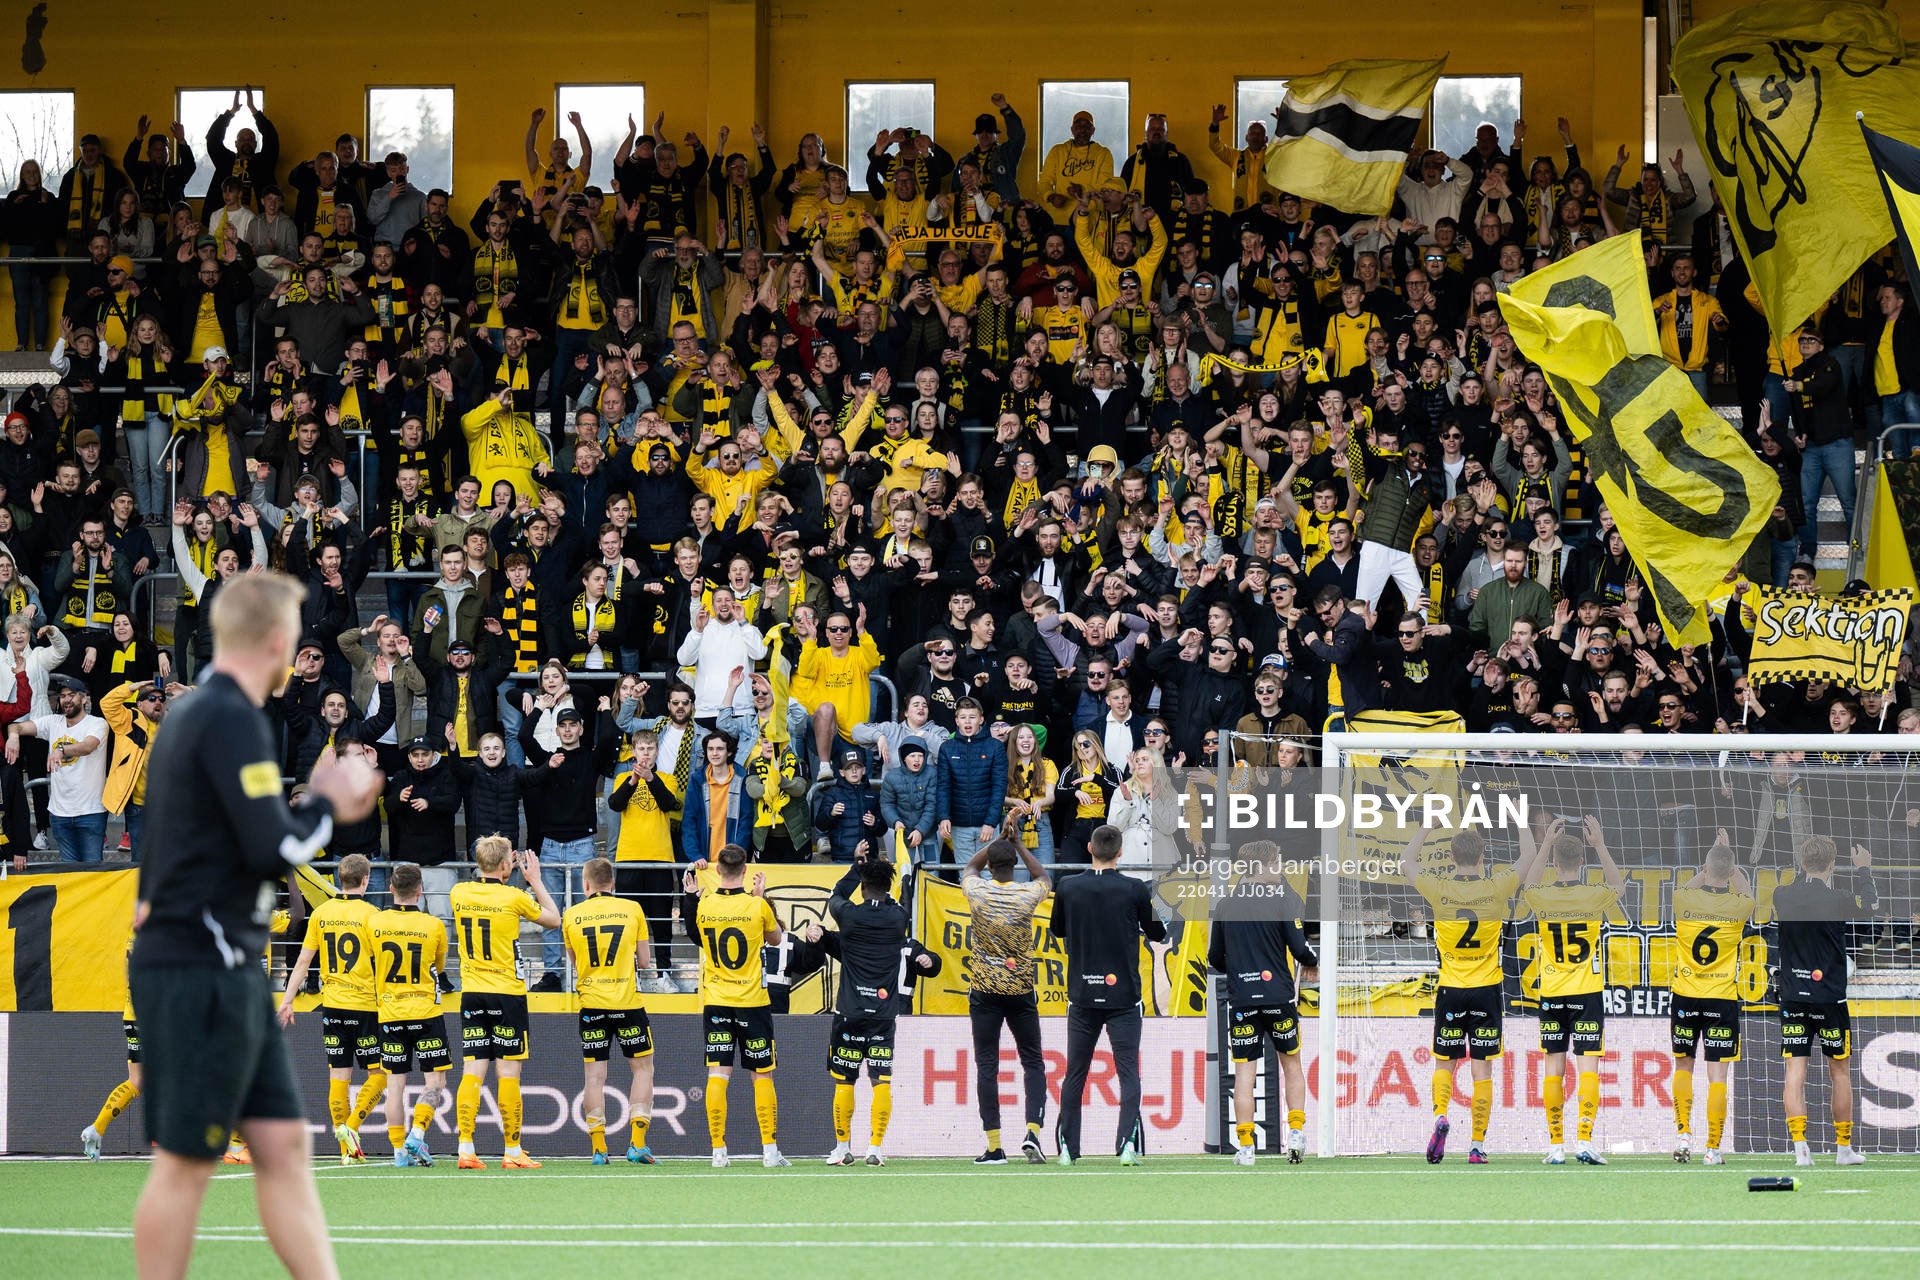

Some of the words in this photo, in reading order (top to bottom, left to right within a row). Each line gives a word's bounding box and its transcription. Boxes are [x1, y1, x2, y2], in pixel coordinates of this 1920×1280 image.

[934, 227, 946, 237] DI
[952, 226, 992, 239] GULE
[1758, 599, 1904, 652] Sektion
[1854, 637, 1890, 695] U
[461, 904, 502, 912] RO-GRUPPEN
[583, 913, 628, 921] RO-GRUPPEN
[326, 920, 362, 928] ROGRUPPEN
[1455, 908, 1481, 949] 2
[382, 930, 428, 939] RO-GRUPPEN
[461, 916, 492, 960] 11
[582, 924, 625, 968] 17
[1548, 922, 1591, 964] 15
[1692, 926, 1720, 966] 6
[324, 932, 361, 974] 19
[703, 927, 748, 970] 10
[381, 941, 423, 984] 21
[1276, 1020, 1292, 1030] EAB
[1577, 1022, 1597, 1031] EAB
[1783, 1025, 1802, 1034] EAB
[464, 1028, 485, 1038] EAB
[496, 1026, 514, 1037] EAB
[584, 1030, 604, 1039] EAB
[619, 1027, 639, 1037] EAB
[1235, 1026, 1253, 1035] EAB
[1442, 1028, 1461, 1037] EAB
[1478, 1029, 1498, 1037] EAB
[1676, 1027, 1693, 1037] EAB
[1709, 1028, 1730, 1038] EAB
[324, 1037, 338, 1045] AB
[710, 1034, 731, 1042] EAB
[1541, 1033, 1564, 1041] rnera
[420, 1040, 441, 1049] EAB
[748, 1039, 766, 1049] EAB
[1673, 1038, 1694, 1047] Cerner
[1821, 1038, 1843, 1047] Cerner
[326, 1047, 344, 1055] nera
[384, 1043, 402, 1053] EAB
[871, 1047, 891, 1057] EAB
[839, 1049, 861, 1059] EAB
[833, 1056, 861, 1069] Cerner
[303, 1084, 688, 1136] BRADOR
